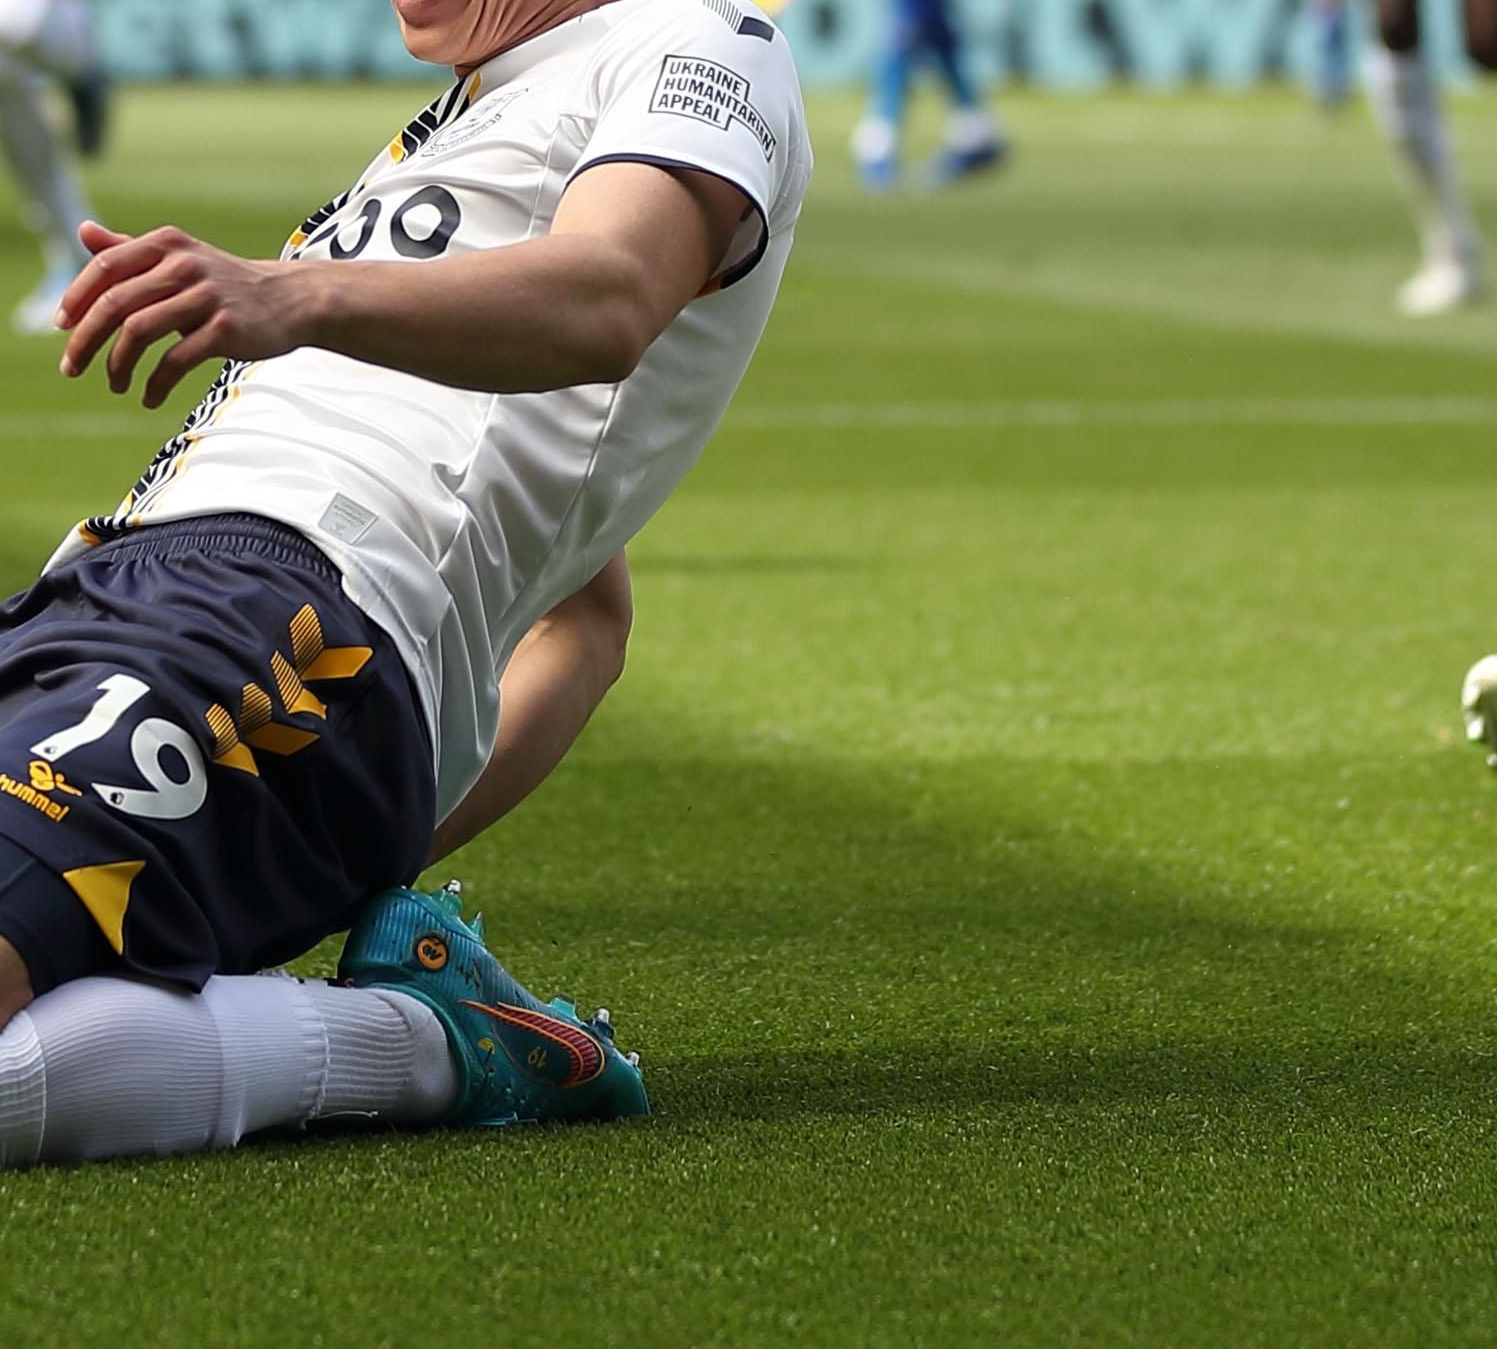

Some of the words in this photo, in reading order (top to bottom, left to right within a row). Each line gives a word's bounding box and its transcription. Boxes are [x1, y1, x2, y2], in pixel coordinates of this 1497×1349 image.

[669, 61, 743, 97] UKRAINE
[658, 93, 722, 124] APPEAL
[663, 78, 774, 152] HUMANITARIAN
[29, 673, 208, 820] 19
